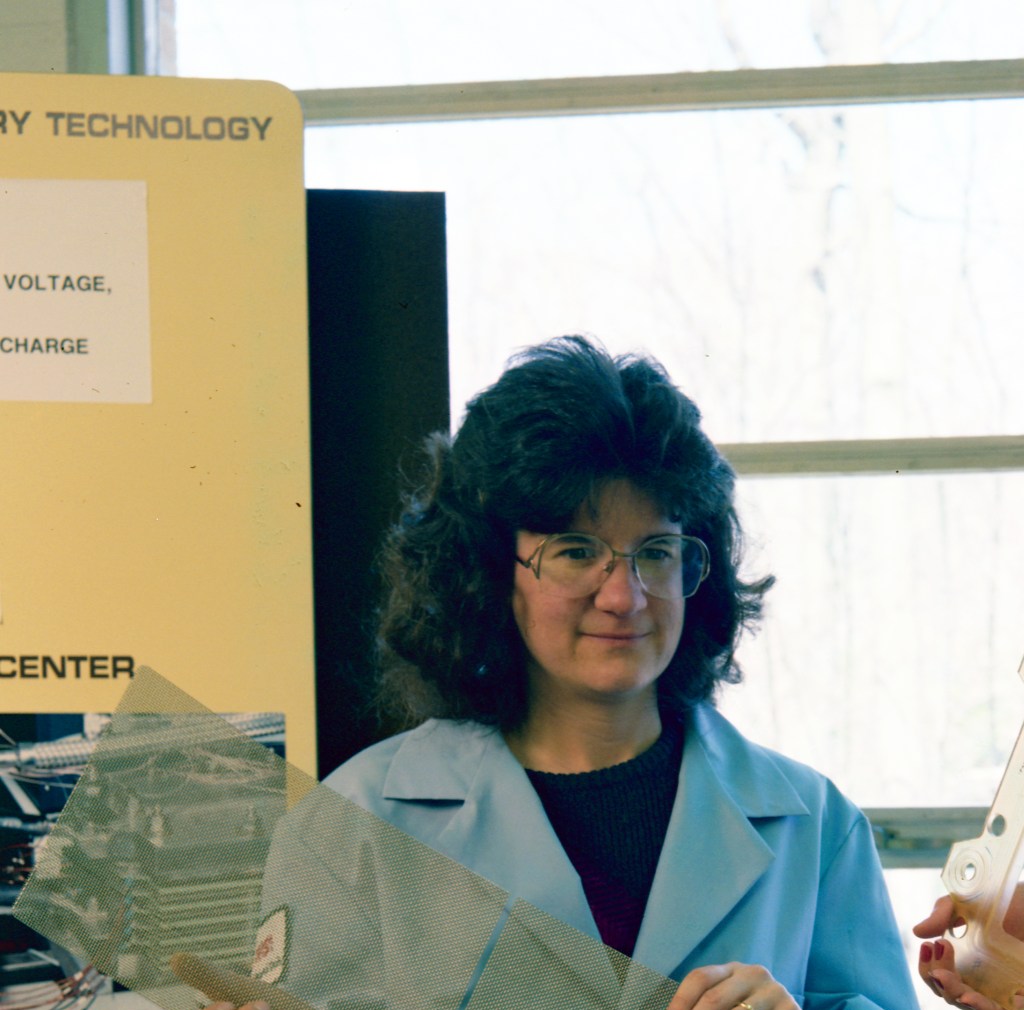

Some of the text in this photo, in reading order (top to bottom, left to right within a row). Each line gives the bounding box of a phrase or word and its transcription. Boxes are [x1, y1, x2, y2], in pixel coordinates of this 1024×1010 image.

[46, 111, 272, 141] TECHNOLOGY
[4, 274, 112, 294] VOLTAGE,
[0, 337, 89, 354] CHARGE
[0, 655, 134, 679] CENTER
